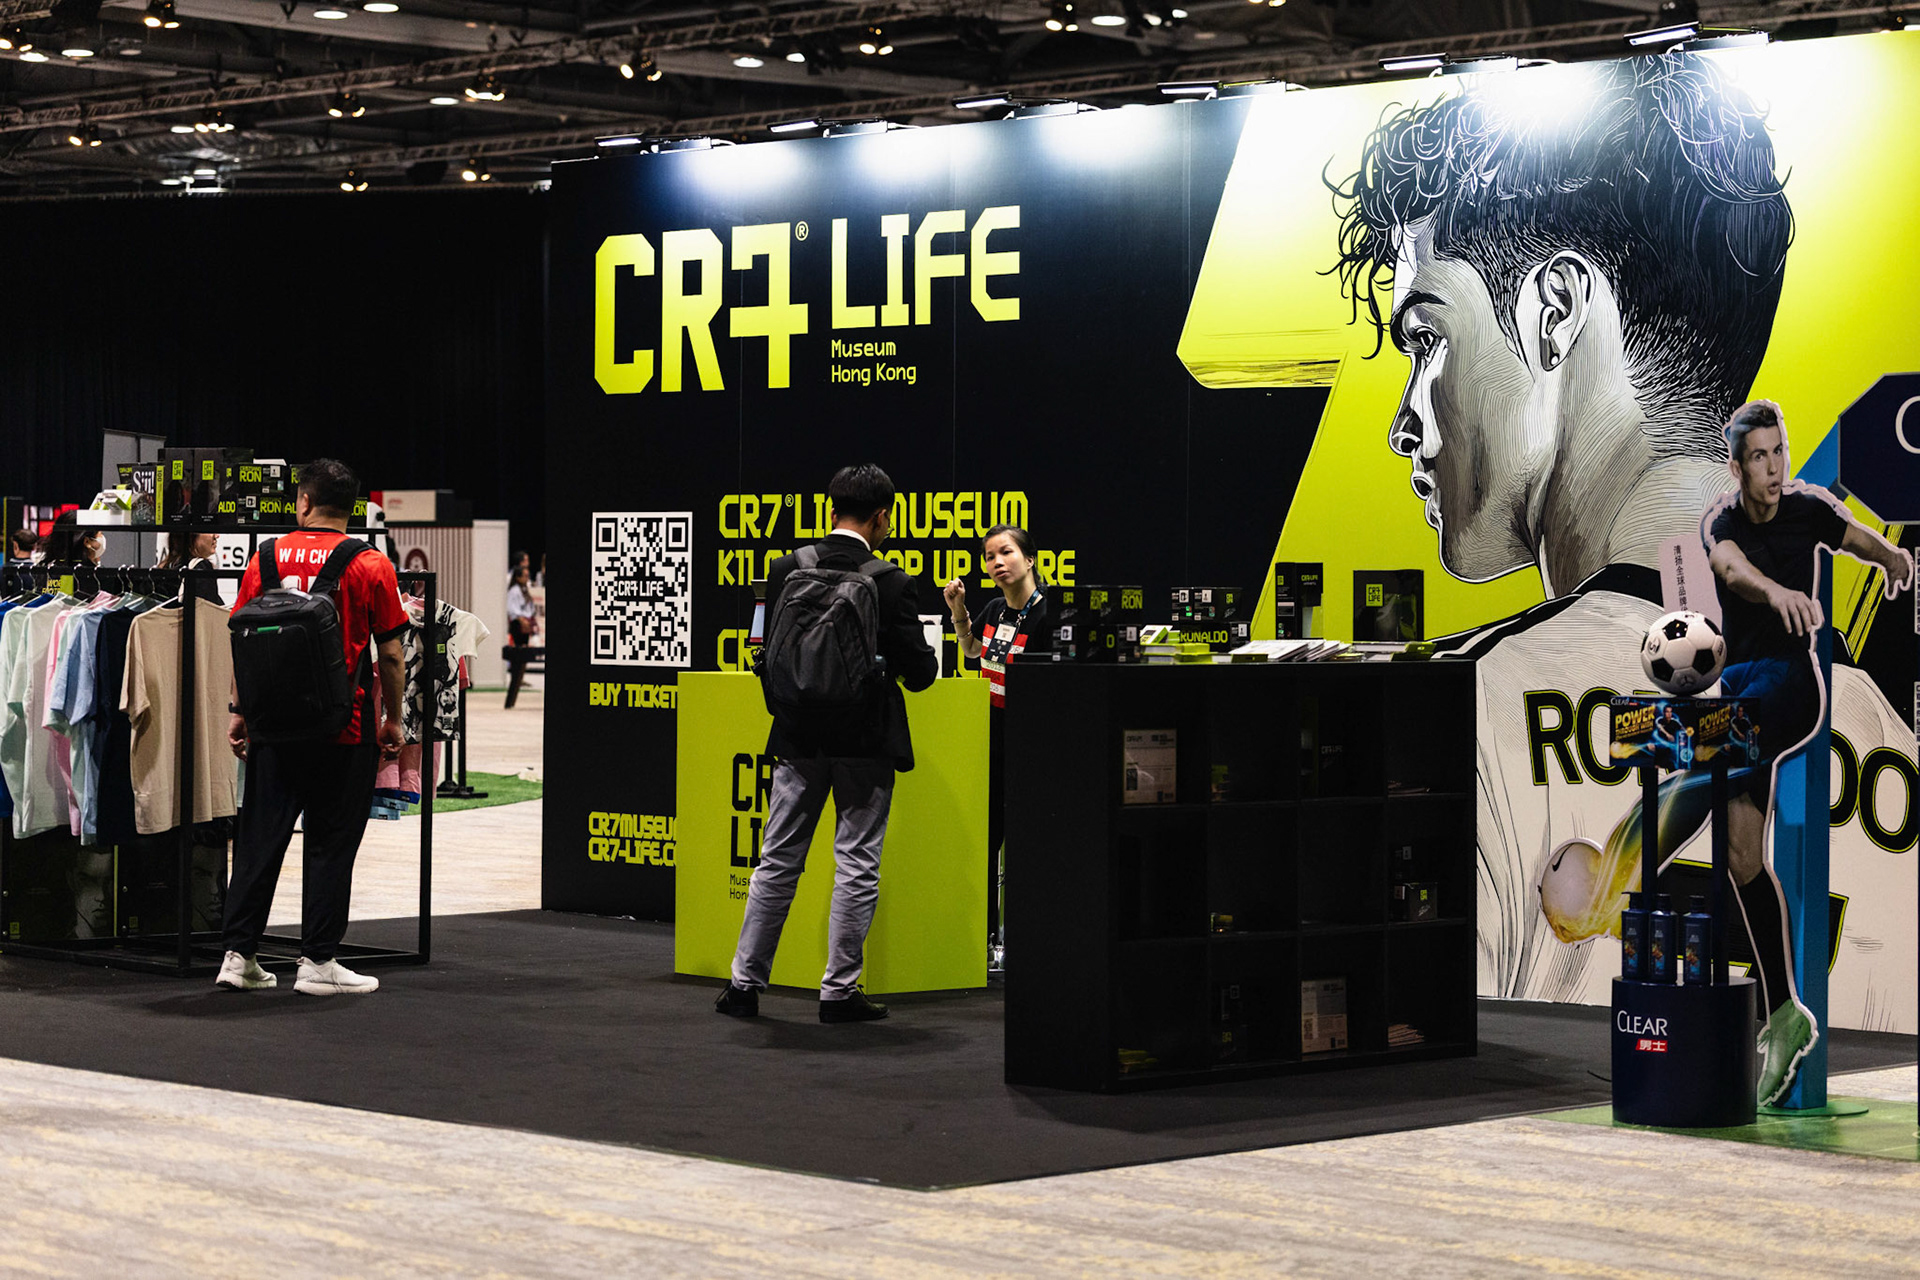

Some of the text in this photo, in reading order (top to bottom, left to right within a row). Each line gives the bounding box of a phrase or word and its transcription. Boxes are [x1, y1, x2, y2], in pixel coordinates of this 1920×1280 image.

[831, 205, 1021, 330] LIFE
[831, 339, 897, 358] Museum
[831, 363, 917, 386] Hong Kong
[239, 470, 263, 482] RON
[218, 501, 236, 513] ALDO
[279, 548, 292, 563] W
[295, 548, 306, 563] H
[933, 550, 972, 588] UP
[618, 580, 665, 597] CR7 LIFE
[1121, 595, 1142, 609] RON
[589, 682, 622, 707] BUY
[1615, 706, 1656, 729] POWER
[1699, 706, 1731, 730] POWER
[1617, 1009, 1668, 1036] CLEAR
[1639, 1039, 1666, 1052] 男士
